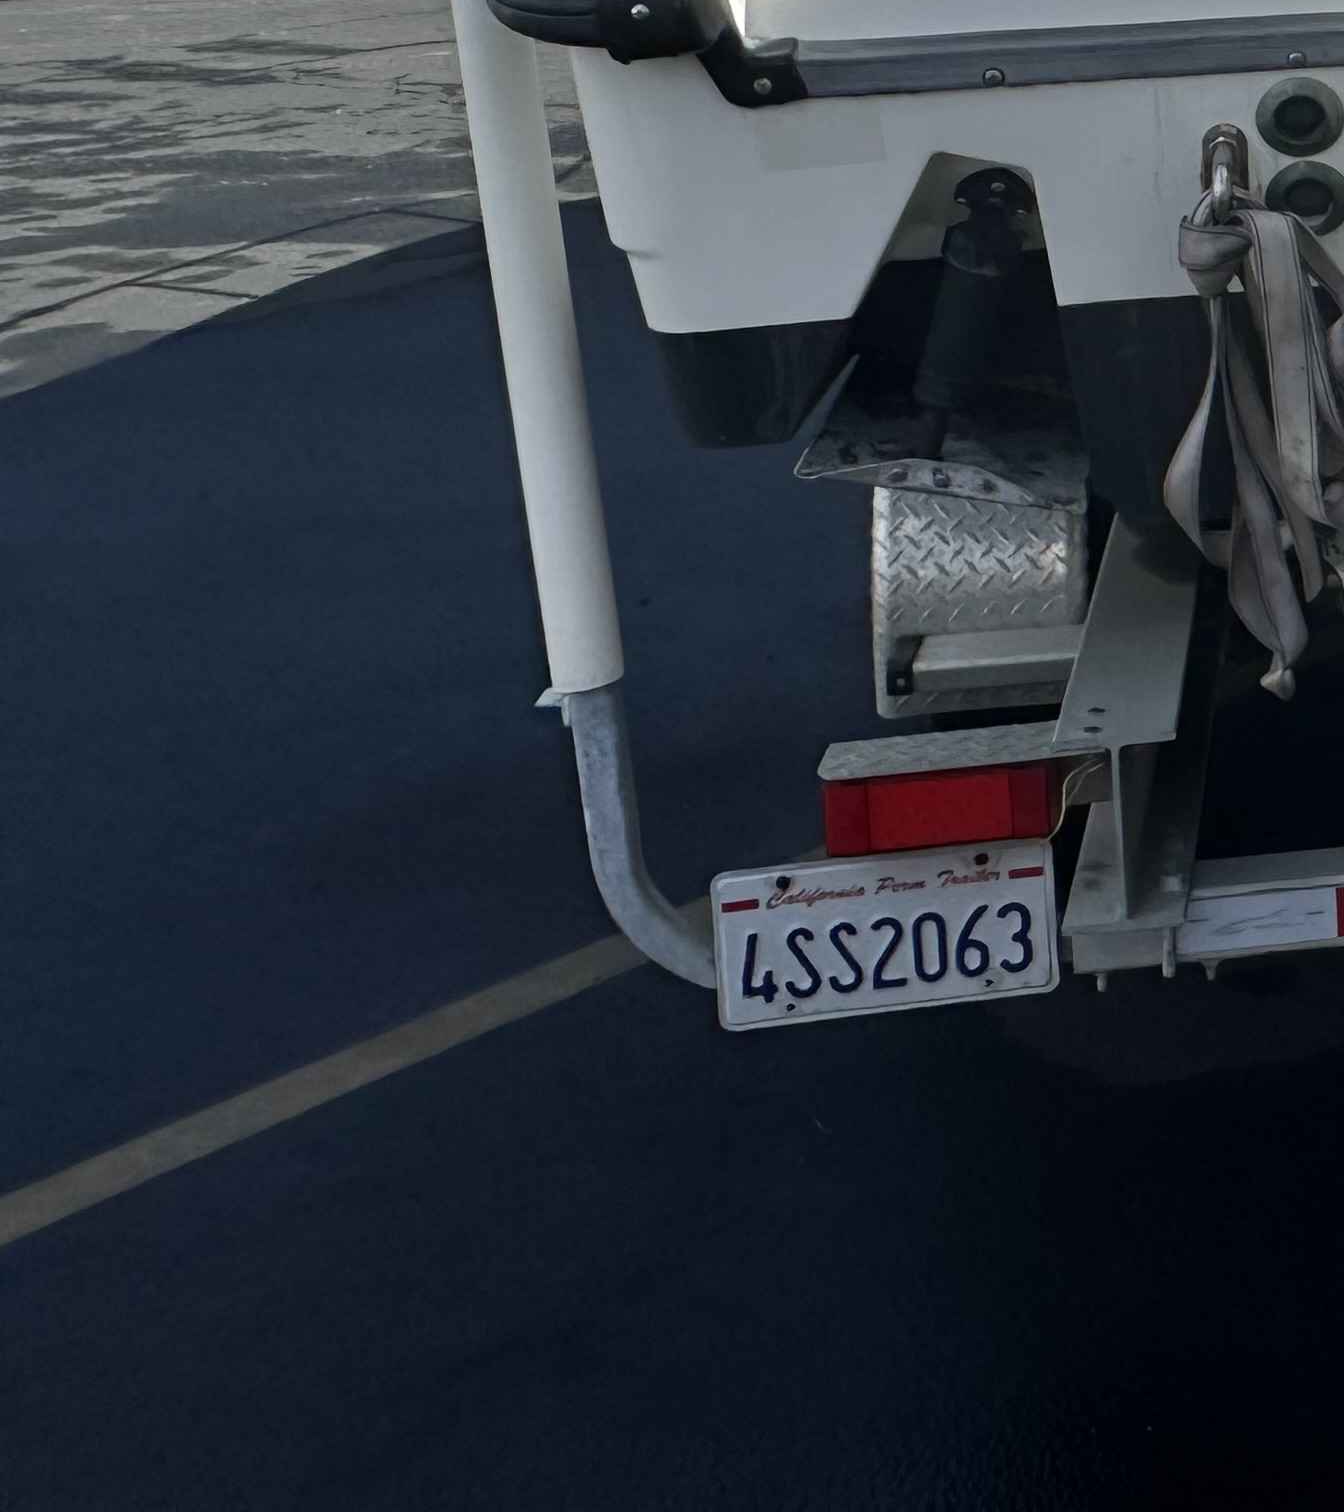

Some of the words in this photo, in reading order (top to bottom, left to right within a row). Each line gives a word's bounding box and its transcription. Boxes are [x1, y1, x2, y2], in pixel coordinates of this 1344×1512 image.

[766, 886, 865, 909] California
[875, 876, 926, 895] Perm
[937, 869, 1001, 887] Trailer
[742, 902, 1034, 1003] 4SS2063
